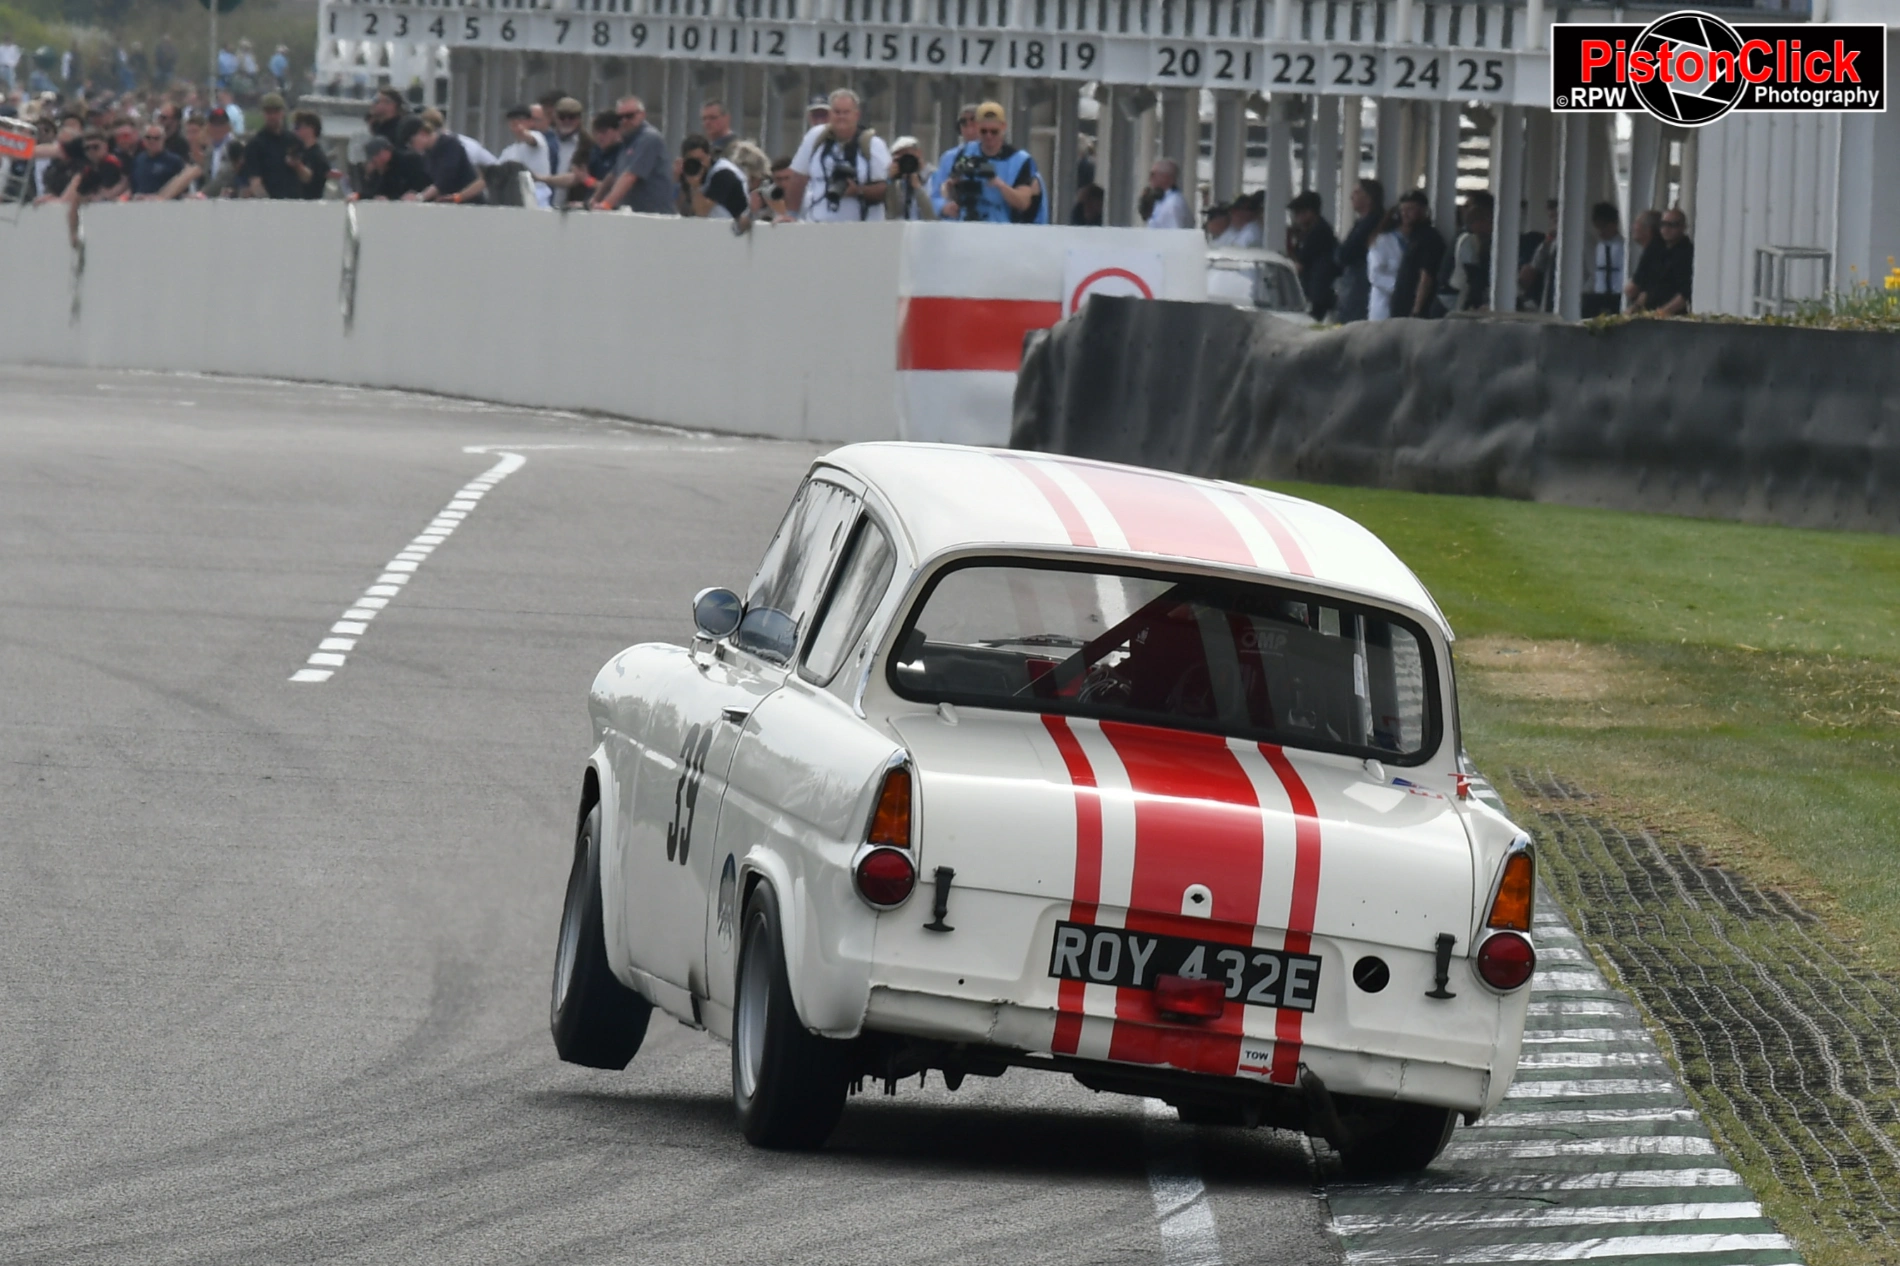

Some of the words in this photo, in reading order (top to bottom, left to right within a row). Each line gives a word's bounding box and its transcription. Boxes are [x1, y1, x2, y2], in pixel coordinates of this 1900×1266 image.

[330, 12, 336, 34] 1
[364, 13, 378, 36] 2
[395, 14, 409, 37] 3
[429, 16, 444, 39] 4
[464, 17, 479, 40] 5
[501, 19, 516, 42] 6
[555, 19, 570, 44] 7
[592, 20, 609, 46] 8
[631, 22, 647, 47] 9
[669, 25, 700, 51] 10
[711, 27, 737, 54] 11
[753, 29, 785, 57] 12
[818, 31, 850, 58] 14
[866, 33, 898, 61] 15
[910, 36, 946, 64] 16
[961, 38, 994, 65] 17
[1010, 40, 1044, 69] 18
[1061, 42, 1096, 70] 19
[1158, 47, 1199, 77] 20
[1215, 49, 1252, 80] 21
[1273, 53, 1315, 84] 22
[1333, 53, 1377, 85] 23
[1395, 56, 1439, 89] 24
[1458, 59, 1503, 92] 25
[1242, 632, 1287, 650] OMP
[667, 723, 712, 865] 39
[1052, 926, 1158, 985] ROY
[1178, 945, 1318, 1009] 432E
[1245, 1050, 1269, 1061] TOW
